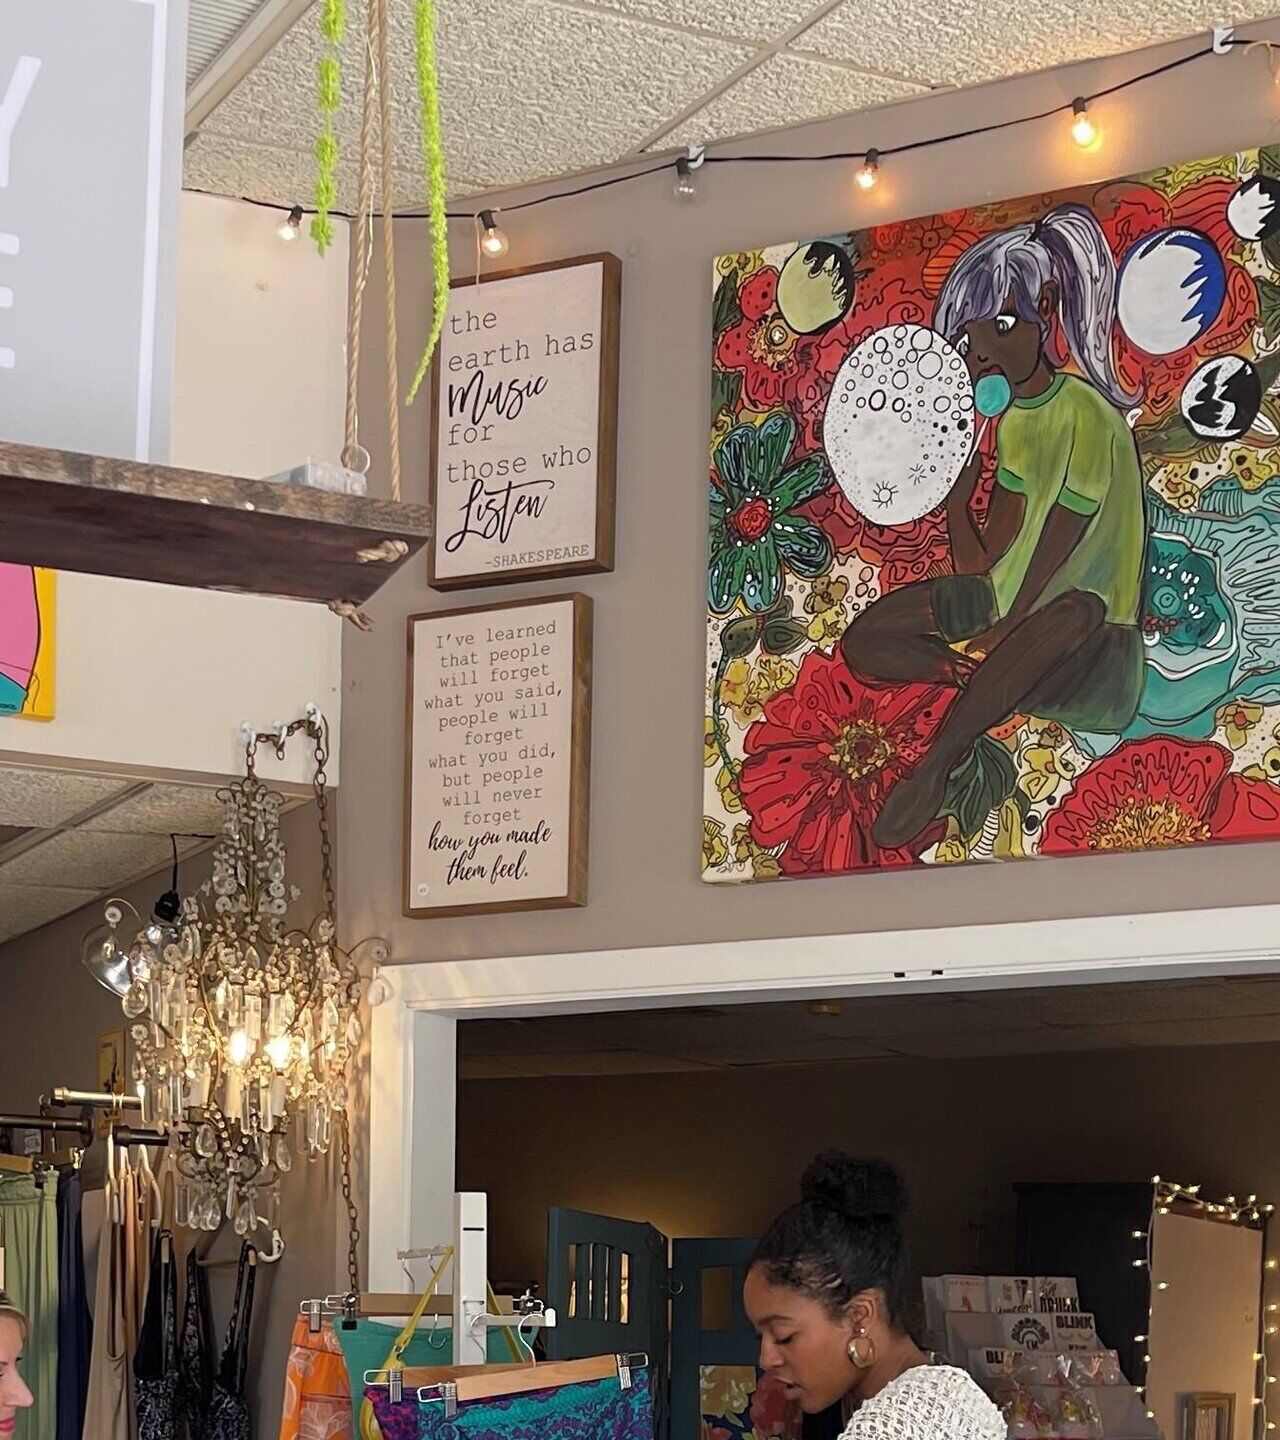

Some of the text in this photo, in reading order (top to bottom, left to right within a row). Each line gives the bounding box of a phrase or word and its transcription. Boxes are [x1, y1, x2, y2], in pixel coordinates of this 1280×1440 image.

[450, 311, 497, 335] the
[448, 332, 595, 372] earth has
[448, 370, 549, 425] Music
[448, 423, 496, 446] for
[446, 446, 591, 483] those who
[445, 478, 555, 552] Listen
[484, 544, 589, 569] -SHAKESPEARE
[436, 620, 557, 649] I've learned
[440, 643, 551, 668] that people
[440, 663, 550, 688] will forget
[424, 682, 563, 710] what you said,
[438, 703, 550, 732] people will
[464, 727, 523, 747] forget
[428, 744, 556, 769] what you did,
[442, 766, 543, 788] but people
[442, 786, 542, 807] will never
[463, 808, 521, 827] forget
[428, 820, 553, 860] how you made
[446, 850, 528, 885] them feel.
[1056, 1315, 1093, 1330] BLINK
